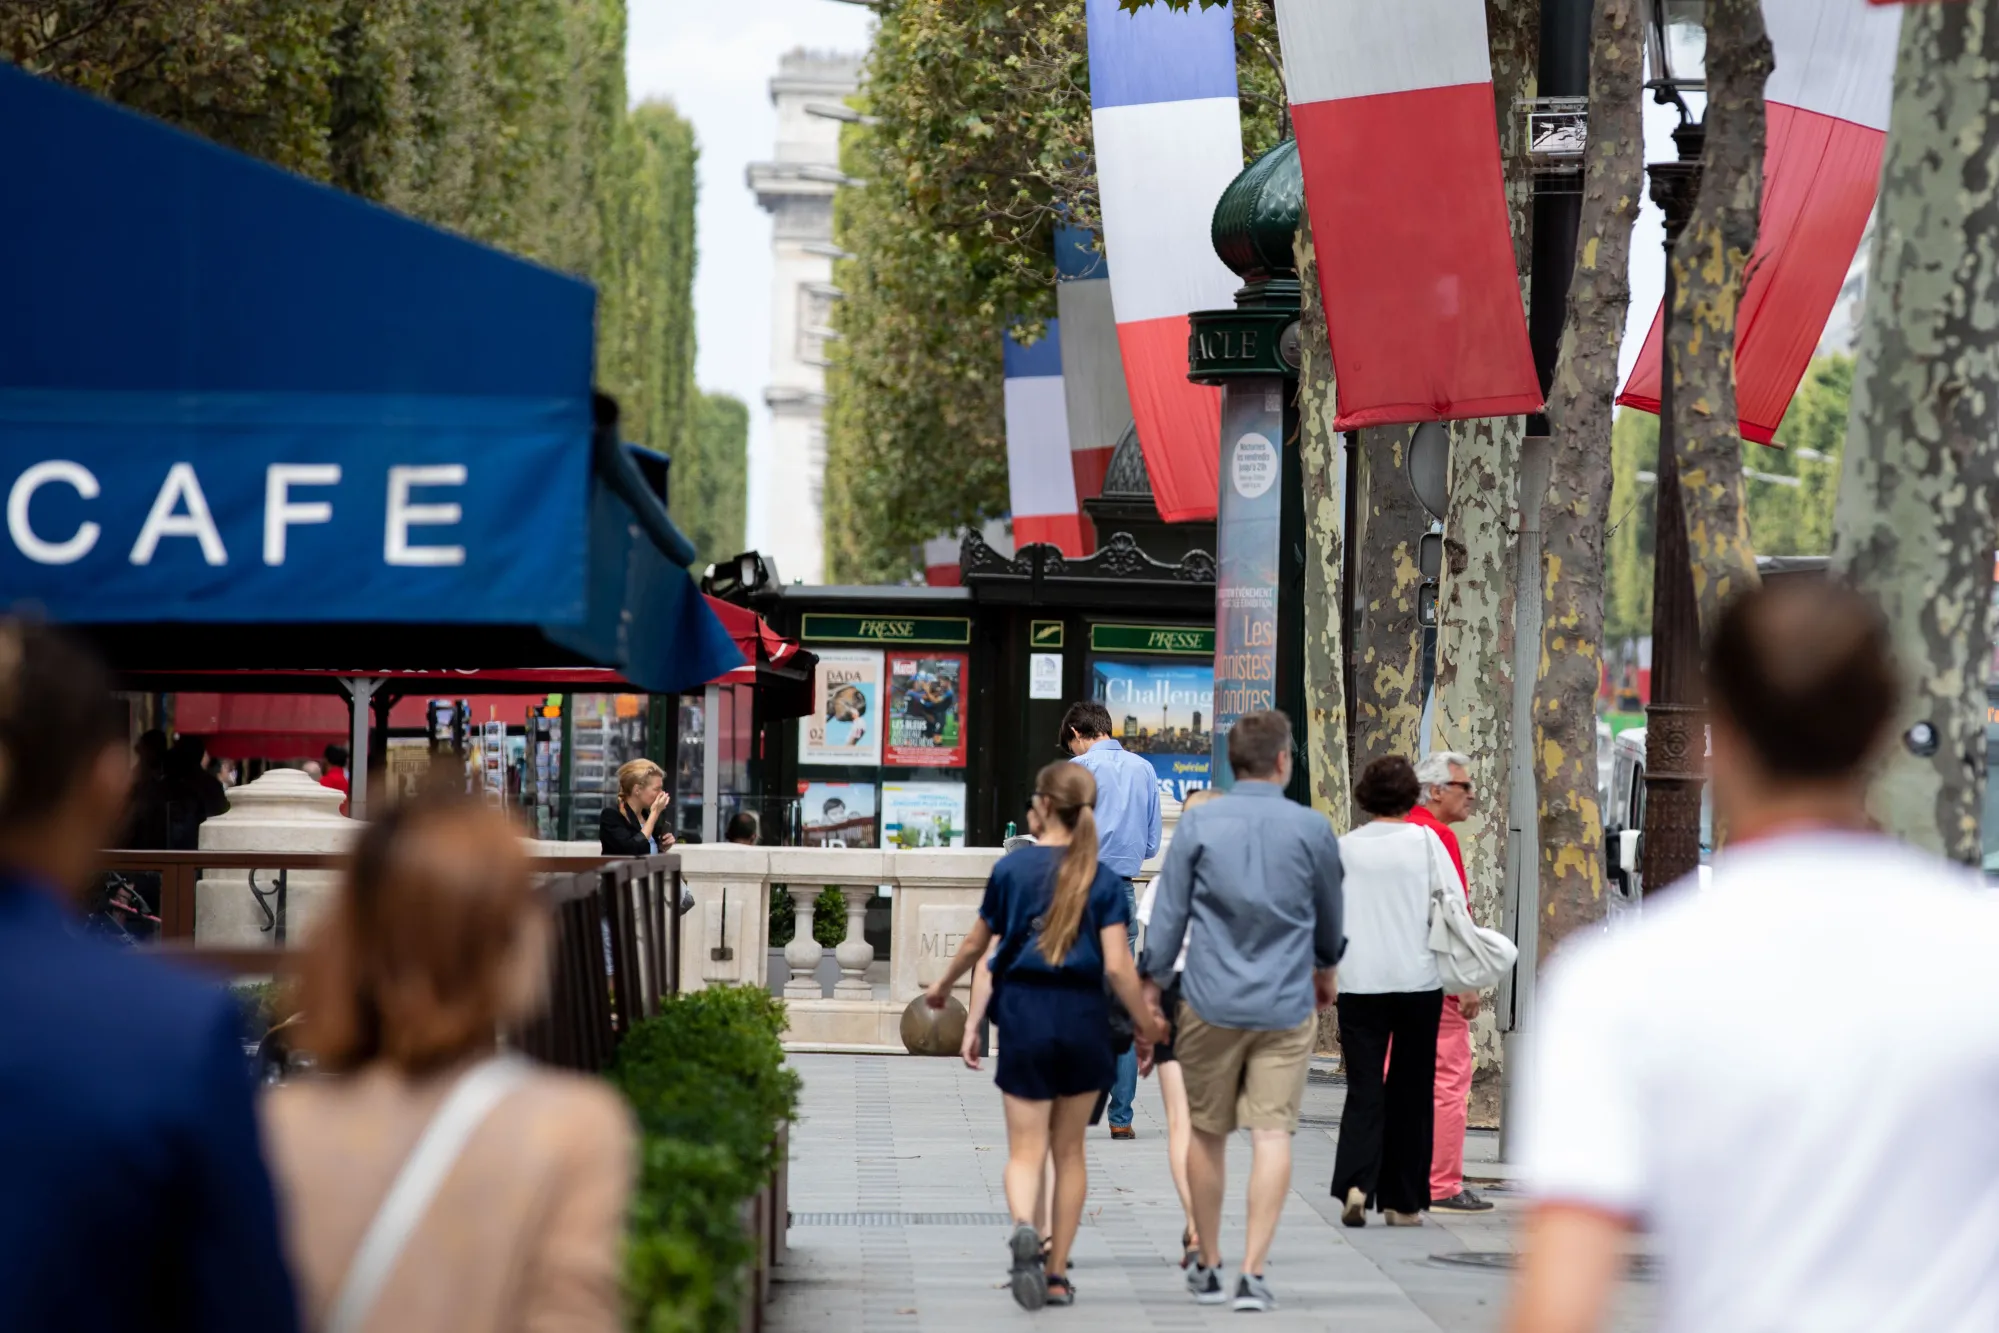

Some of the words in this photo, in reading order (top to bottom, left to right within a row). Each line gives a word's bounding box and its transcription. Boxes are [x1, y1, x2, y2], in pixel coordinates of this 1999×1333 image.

[1192, 330, 1258, 360] ACLE
[7, 459, 467, 566] CAFE
[858, 620, 915, 639] PRESSE
[1148, 631, 1204, 650] PRESSE
[1244, 615, 1272, 647] Les
[827, 670, 862, 682] DADA
[1219, 650, 1271, 681] nnistes
[1106, 678, 1214, 708] Challeng
[1220, 681, 1271, 715] Londres
[1172, 762, 1209, 774] Spécial
